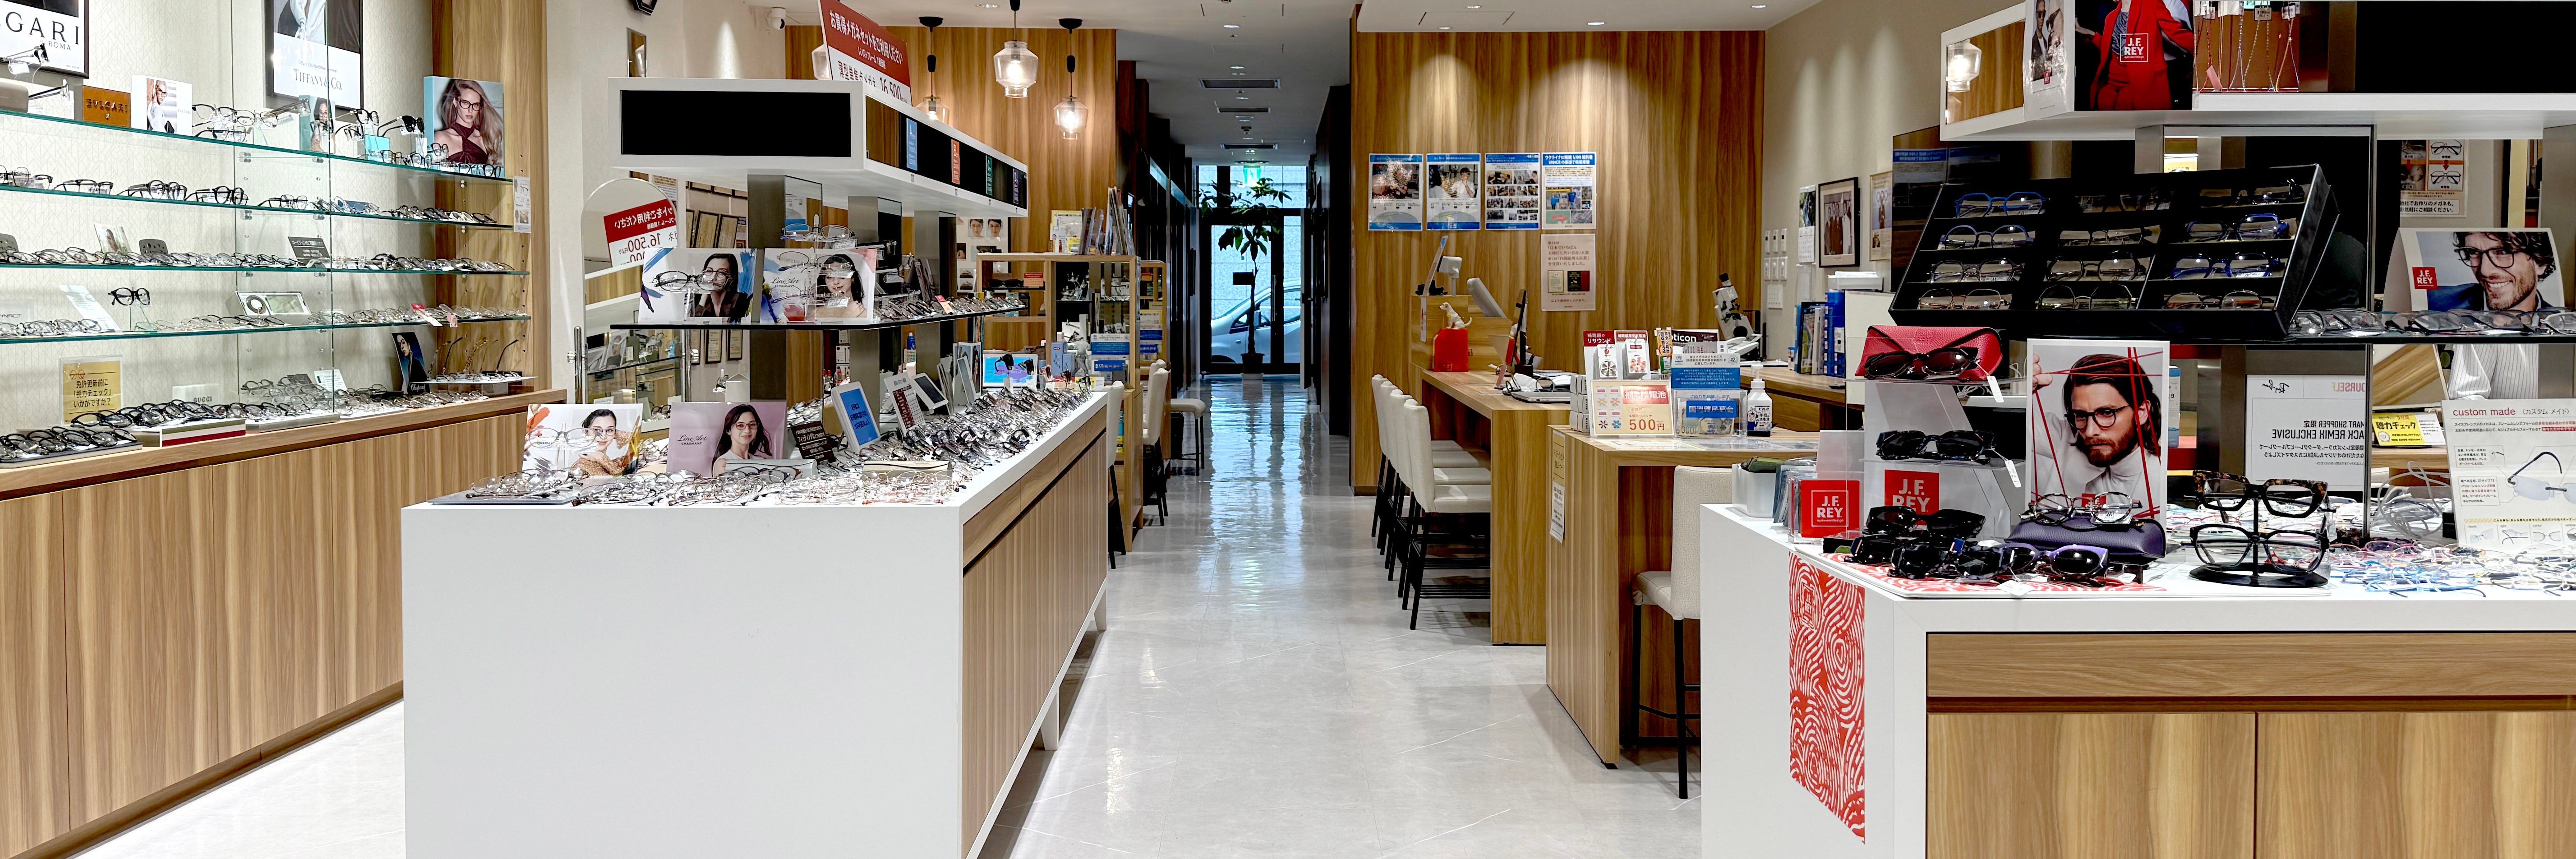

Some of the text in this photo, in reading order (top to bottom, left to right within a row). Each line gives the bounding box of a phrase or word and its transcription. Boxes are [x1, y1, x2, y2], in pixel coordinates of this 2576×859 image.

[0, 12, 80, 45] GARI
[829, 9, 903, 64] お買得メガネセットをご利用ください
[2128, 37, 2142, 46] J.F.
[48, 41, 71, 51] ROMA
[2124, 46, 2144, 55] REY
[880, 77, 902, 101] 16500
[86, 98, 128, 114] BVLGARI
[76, 379, 108, 388] 免許更新前に
[2490, 407, 2516, 416] made
[1629, 419, 1664, 431] 500円
[1899, 479, 1925, 496] J.F.
[1821, 496, 1840, 507] J.F.
[1817, 507, 1842, 518] REY
